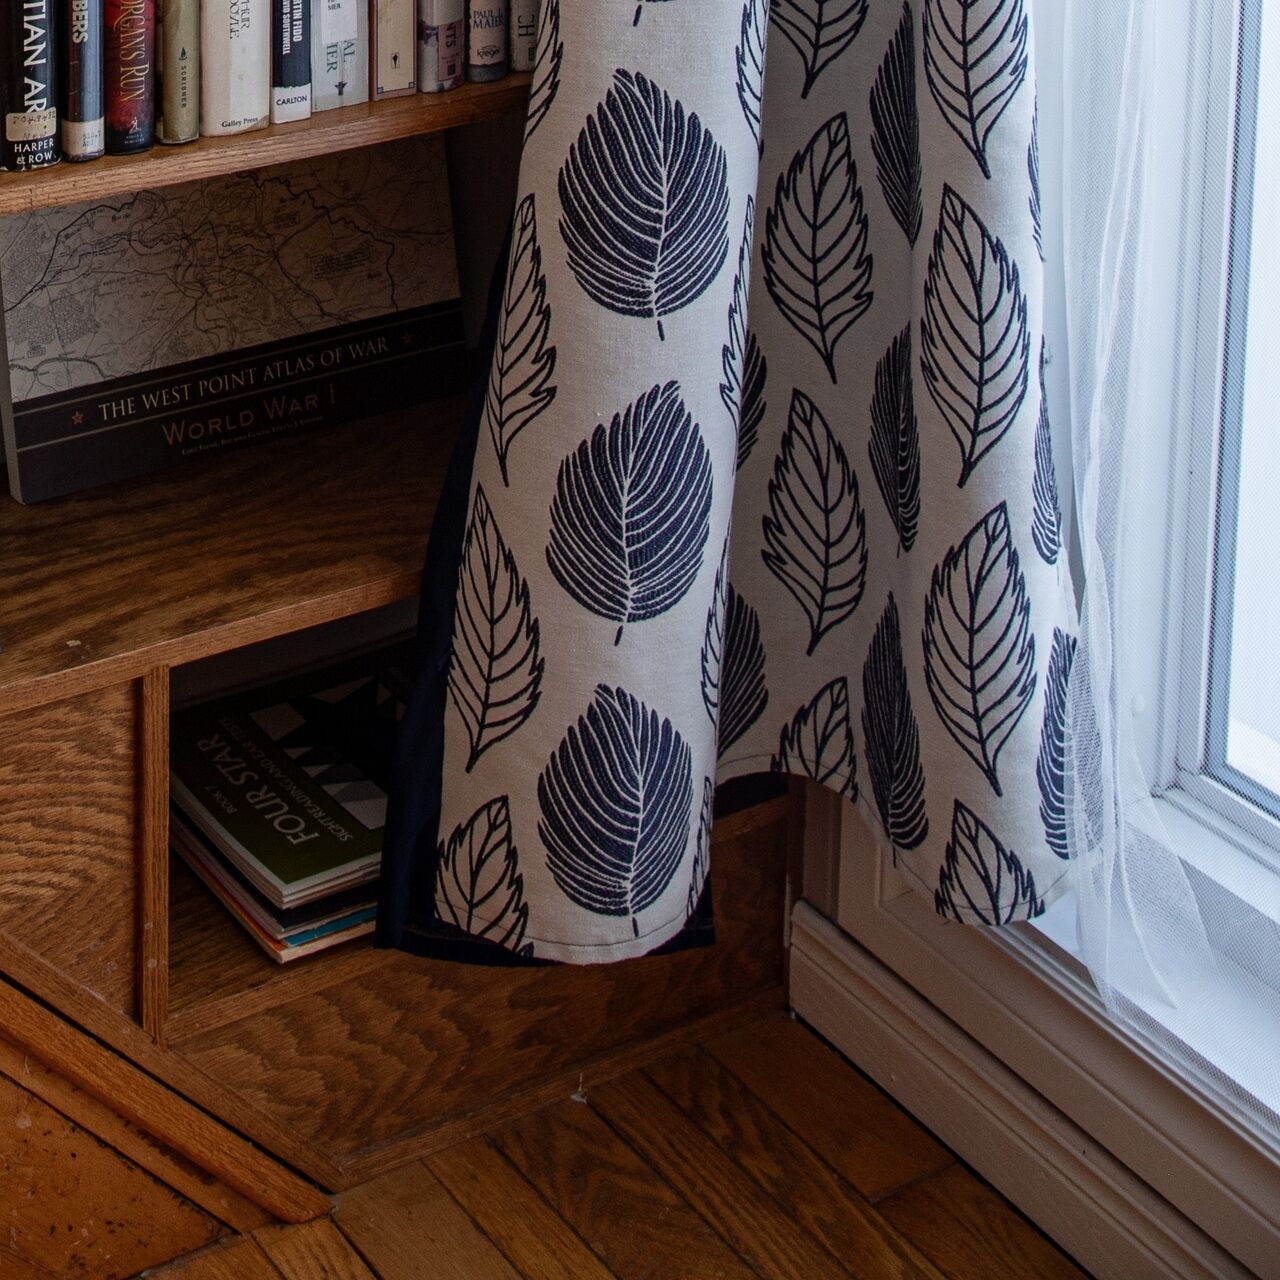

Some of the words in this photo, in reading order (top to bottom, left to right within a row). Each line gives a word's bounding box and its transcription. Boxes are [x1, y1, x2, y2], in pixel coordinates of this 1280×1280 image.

[276, 95, 307, 106] CARLTON
[98, 399, 139, 421] THE
[143, 384, 194, 410] WEST
[198, 370, 258, 400] POINT
[262, 357, 318, 385] ATLAS
[322, 350, 345, 370] OF
[347, 336, 390, 361] WAR
[246, 784, 320, 846] FOUR
